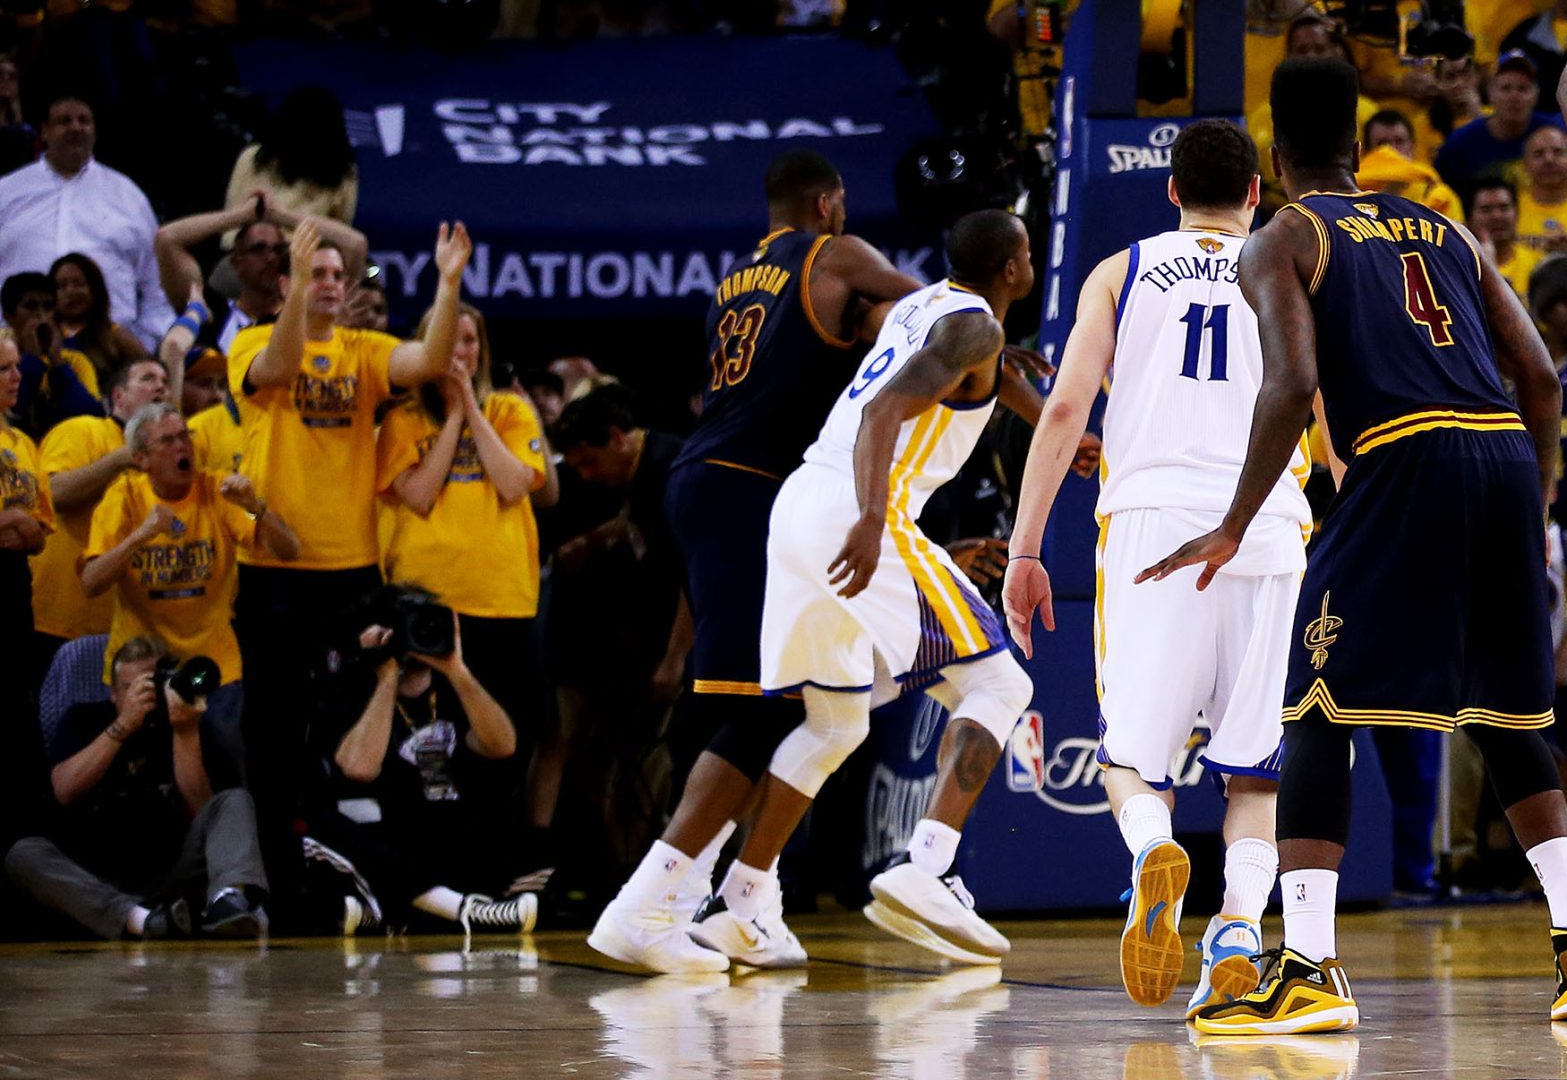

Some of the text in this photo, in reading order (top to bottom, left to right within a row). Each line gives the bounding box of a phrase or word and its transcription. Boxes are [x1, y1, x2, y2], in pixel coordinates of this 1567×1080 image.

[432, 98, 613, 124] CITY
[441, 117, 886, 146] NATIONAL
[455, 142, 708, 167] BANK
[1107, 144, 1172, 174] SPAL
[369, 249, 433, 298] TY
[1139, 256, 1240, 293] THOMPS
[1400, 251, 1455, 347] 4
[711, 302, 766, 391] 13
[1178, 302, 1231, 381] 11
[850, 347, 895, 399] 9
